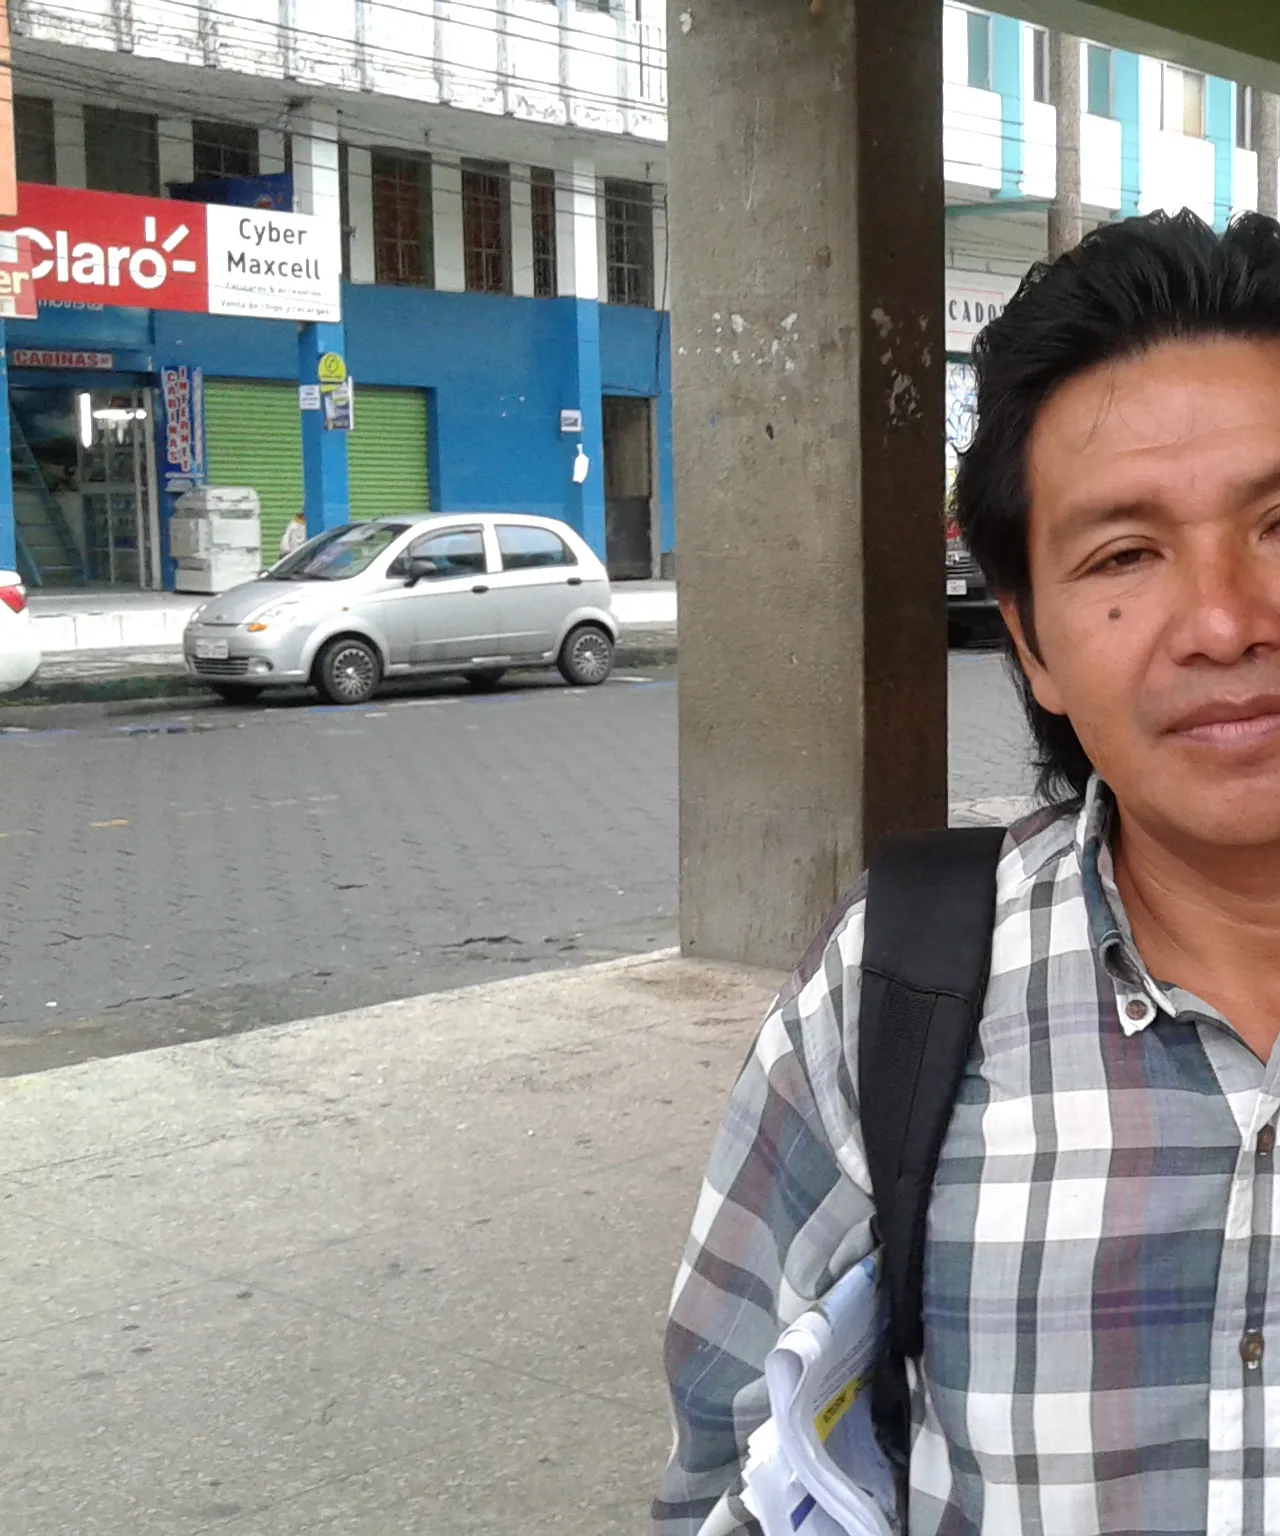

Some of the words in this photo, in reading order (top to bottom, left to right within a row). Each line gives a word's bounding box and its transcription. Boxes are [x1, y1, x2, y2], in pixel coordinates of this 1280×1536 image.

[239, 218, 307, 246] Cyber
[14, 226, 167, 289] Claro
[227, 250, 320, 280] Maxcell
[15, 351, 98, 367] CABINAS
